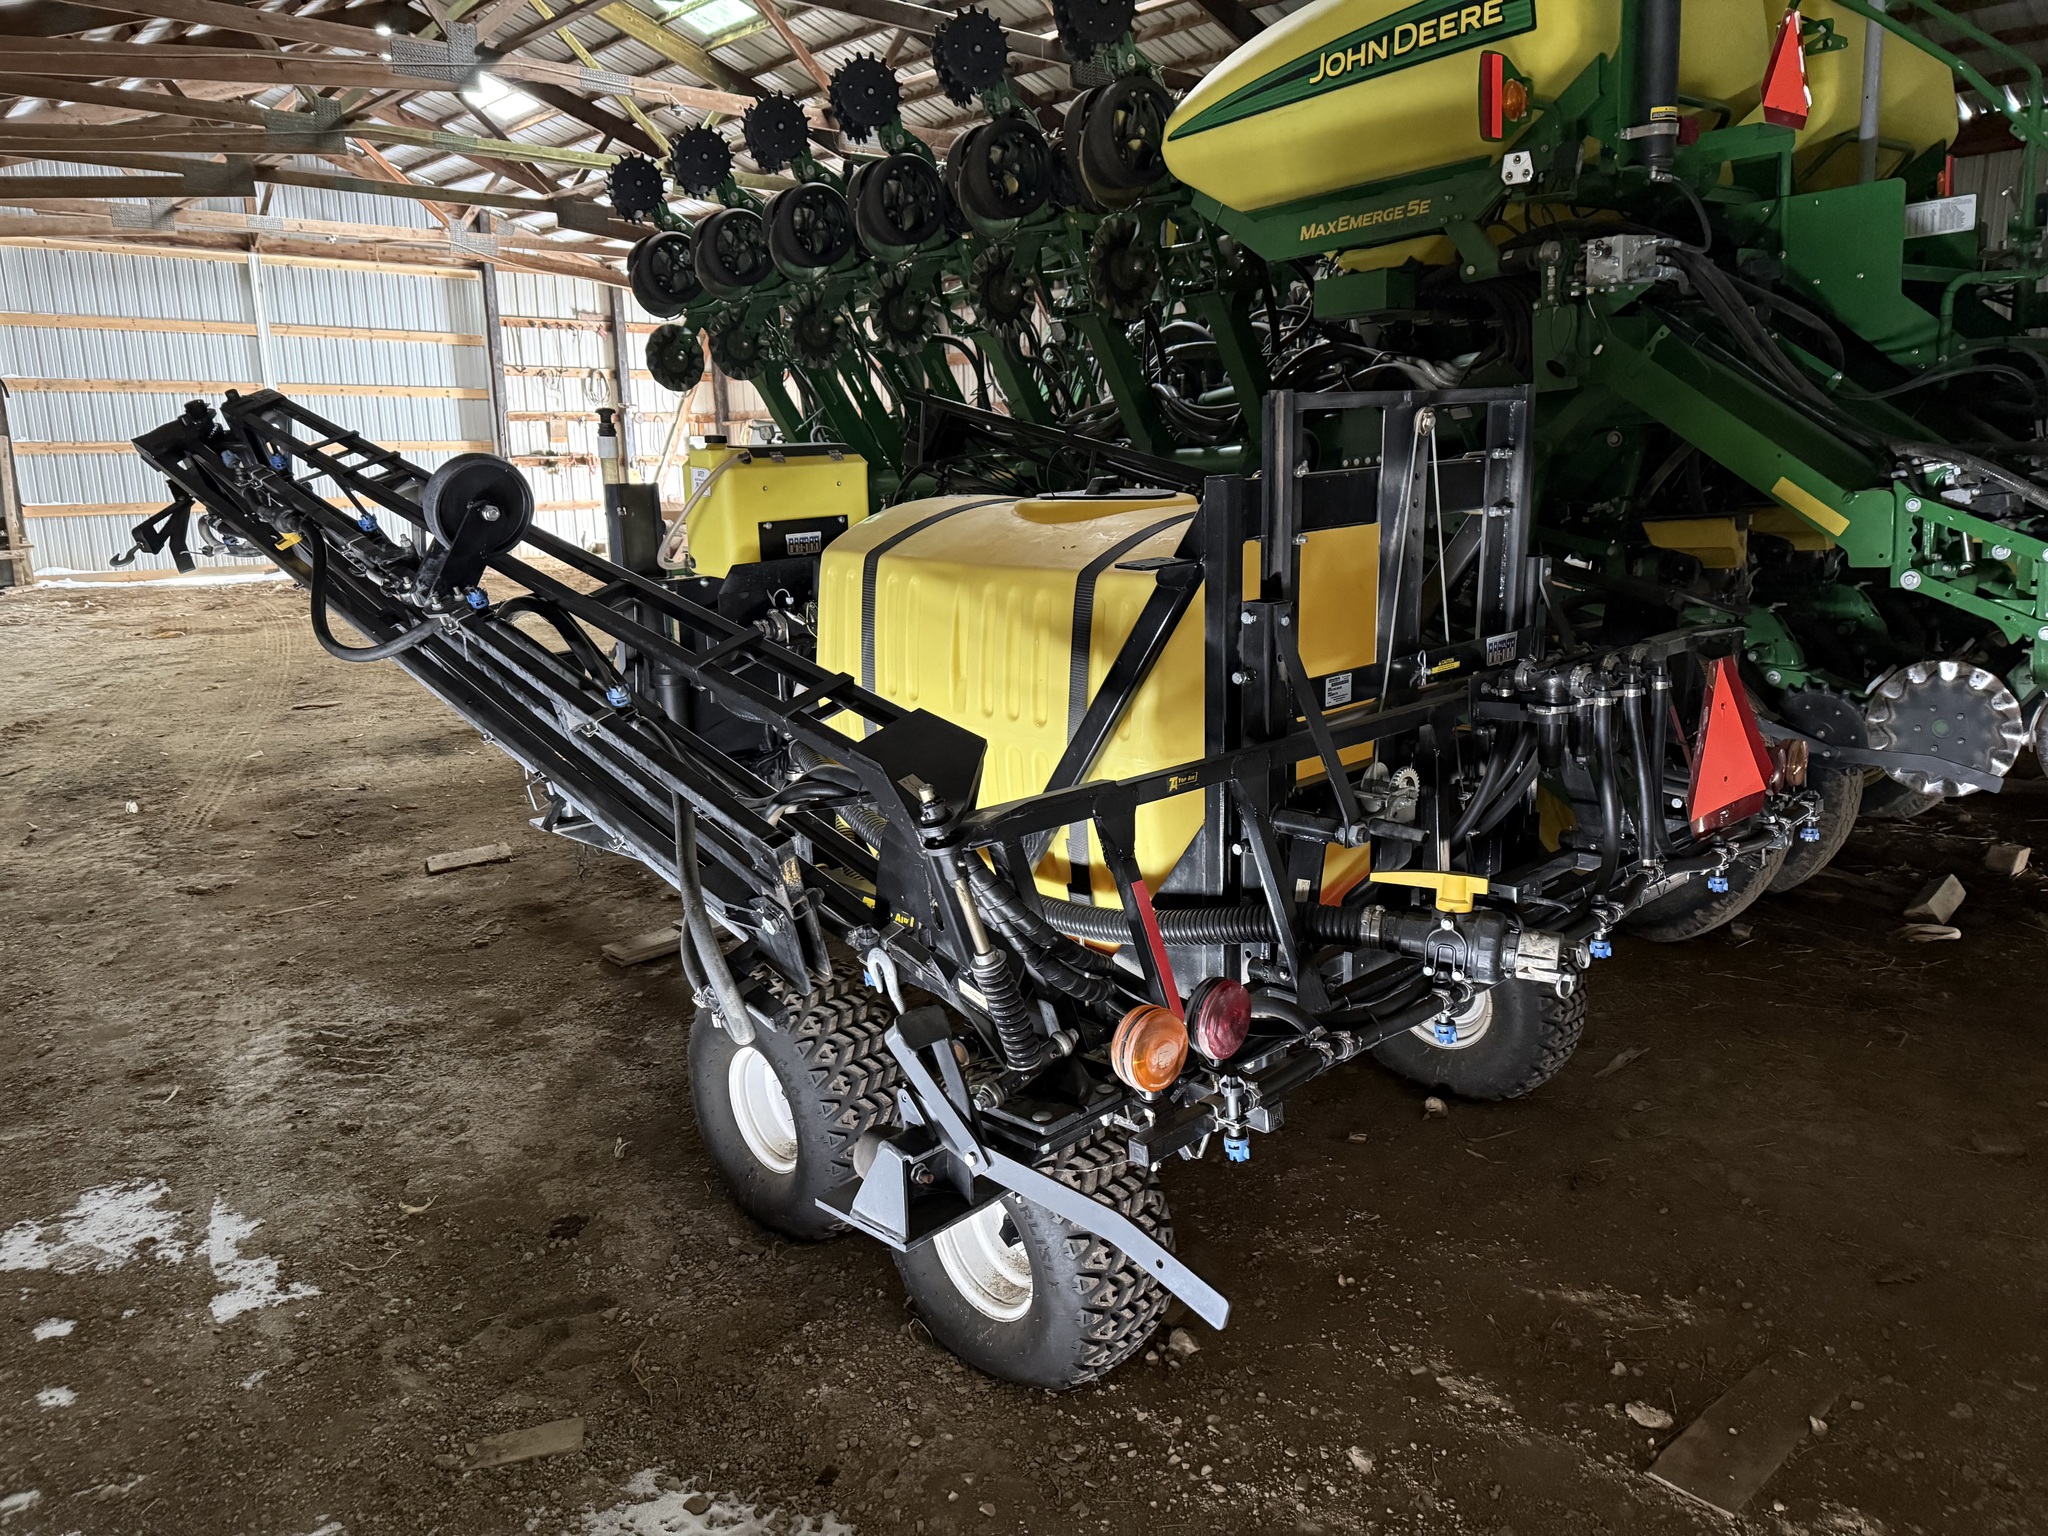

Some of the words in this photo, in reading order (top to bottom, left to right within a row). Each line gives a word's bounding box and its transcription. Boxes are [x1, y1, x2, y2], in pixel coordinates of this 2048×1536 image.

[1309, 36, 1389, 84] JOHN
[1393, 1, 1504, 56] DEERE
[1407, 199, 1431, 217] 5E
